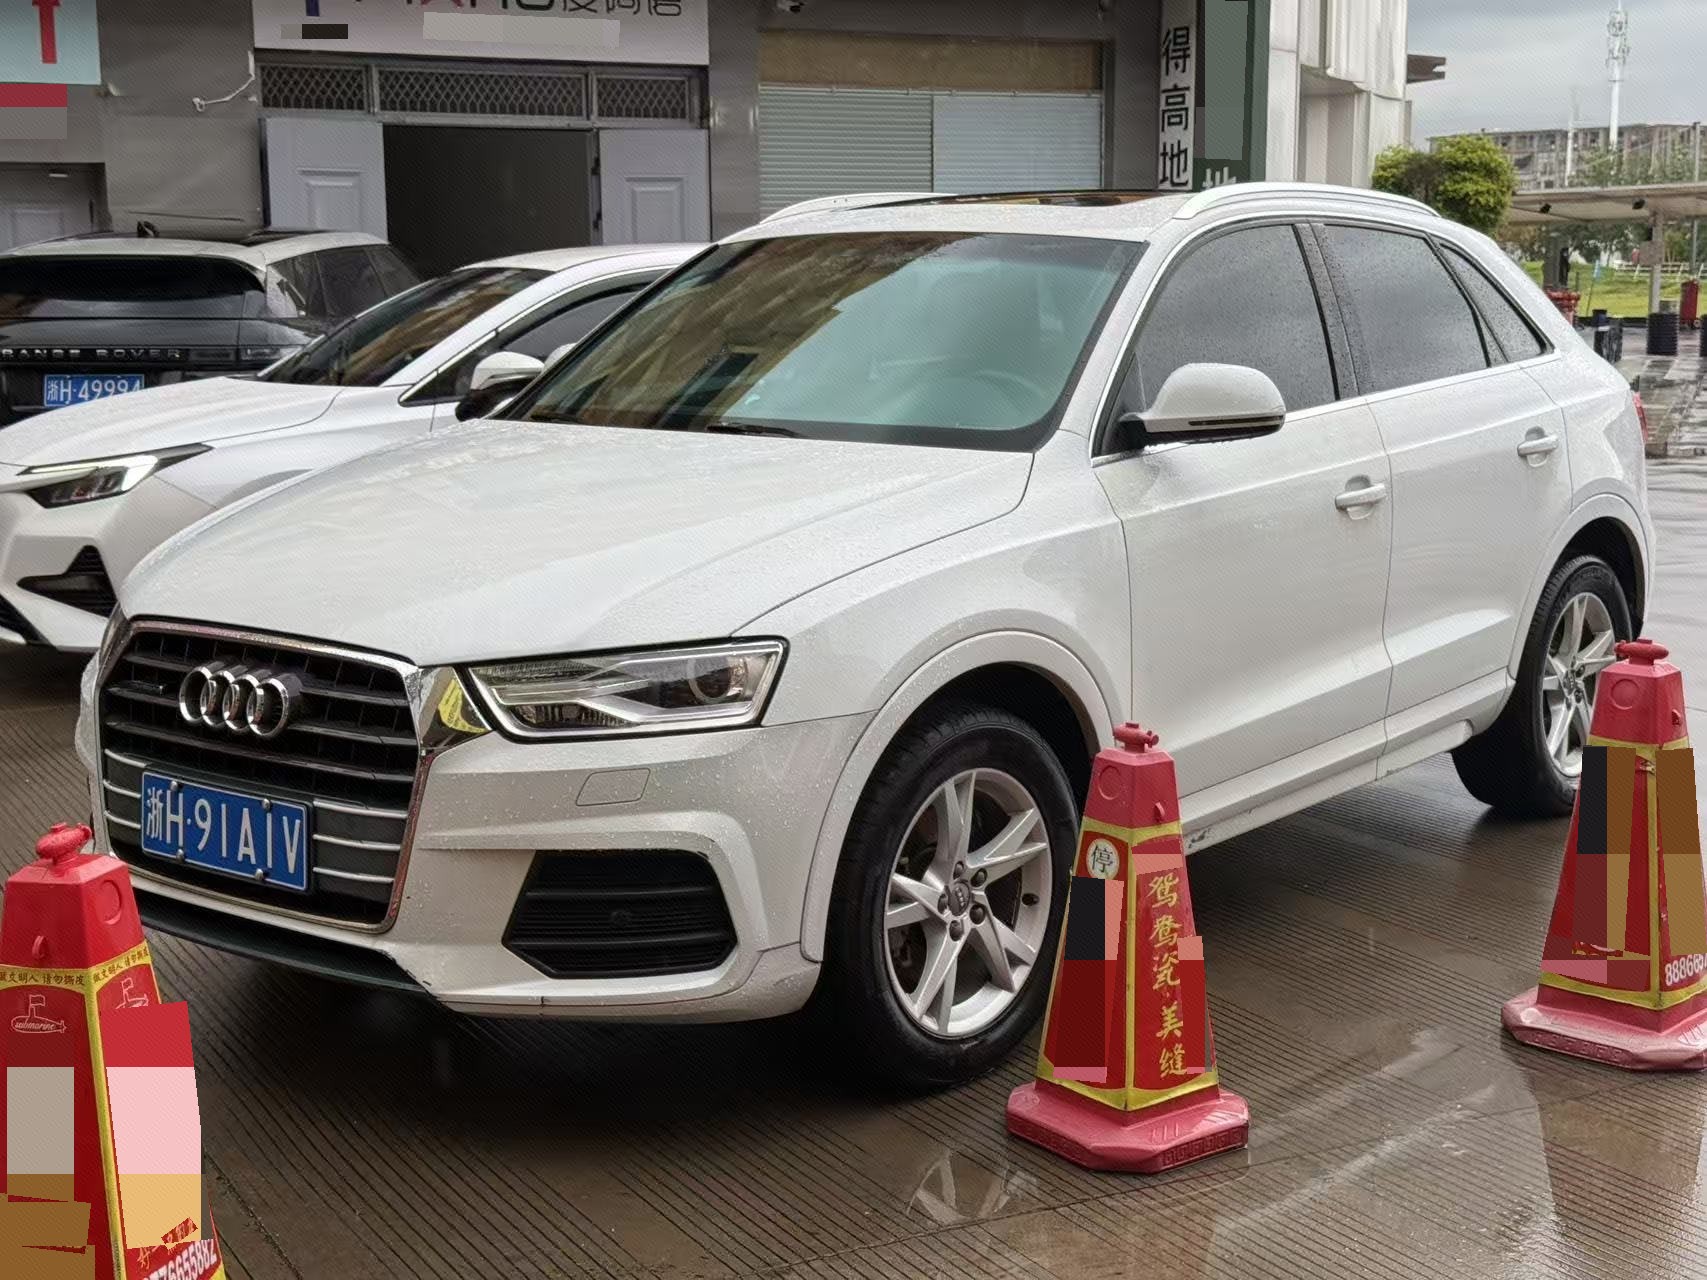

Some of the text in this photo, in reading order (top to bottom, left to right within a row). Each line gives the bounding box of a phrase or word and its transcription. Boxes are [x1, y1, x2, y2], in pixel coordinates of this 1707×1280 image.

[1160, 26, 1190, 188] 得高地
[2, 349, 181, 359] RANGE ROVER
[15, 1018, 55, 1031] submarine
